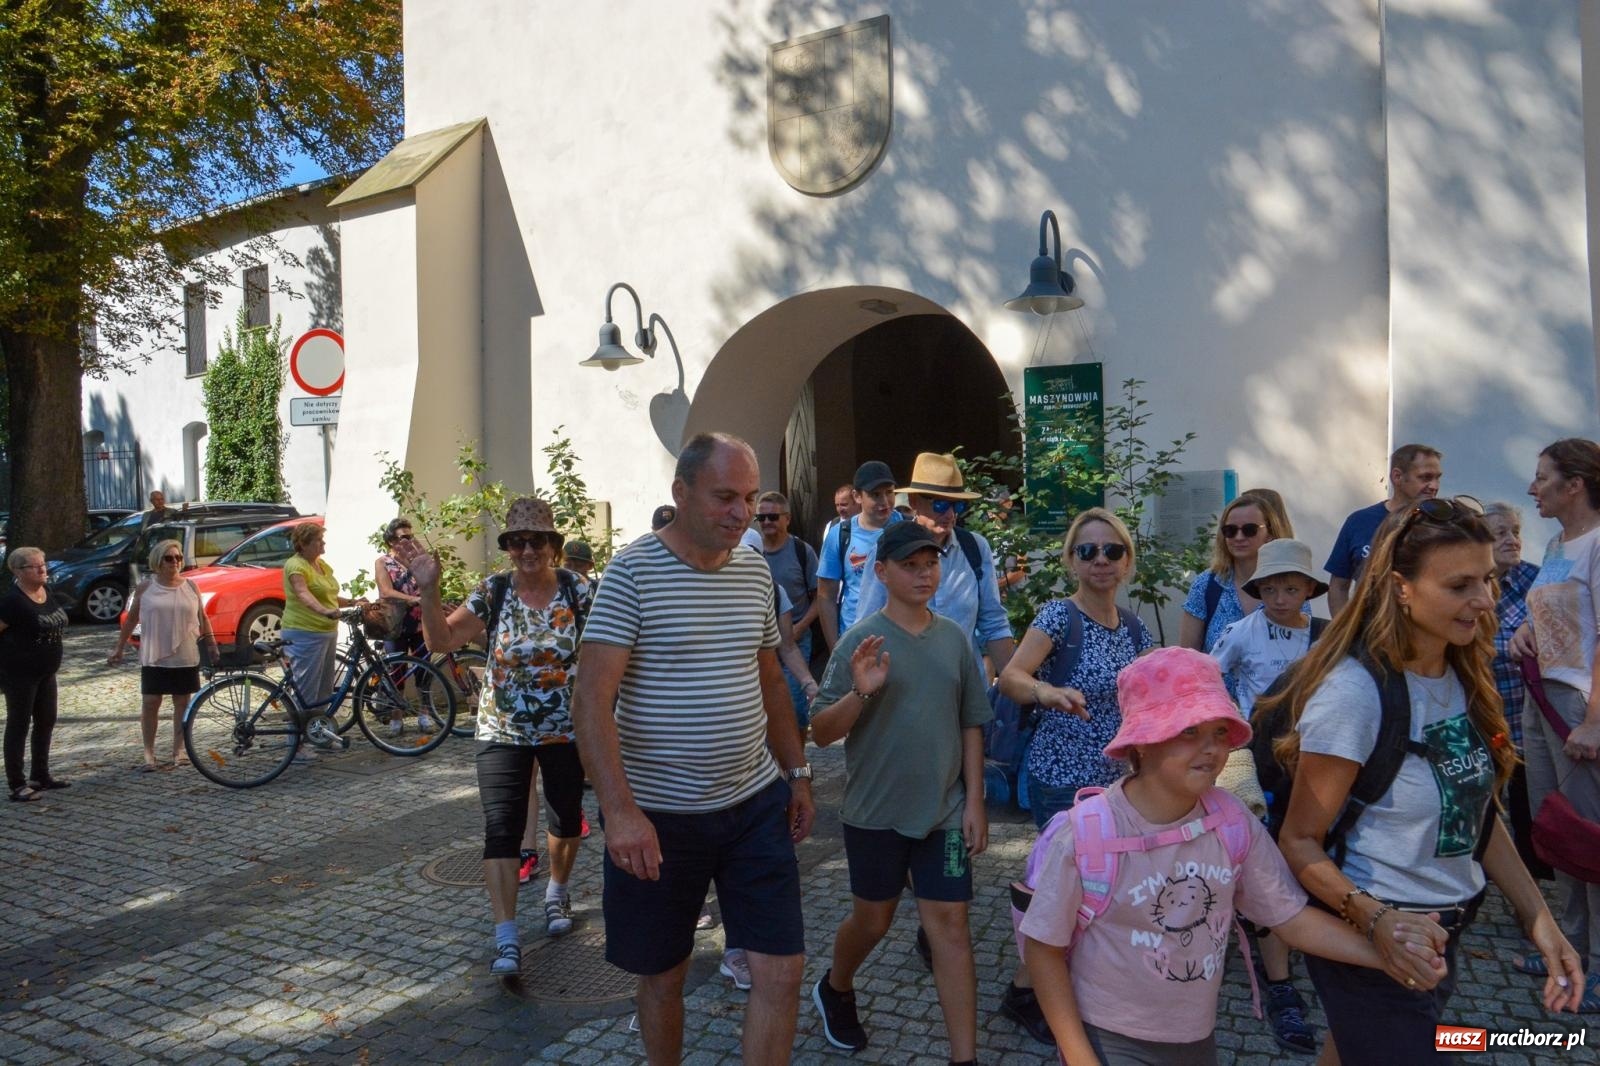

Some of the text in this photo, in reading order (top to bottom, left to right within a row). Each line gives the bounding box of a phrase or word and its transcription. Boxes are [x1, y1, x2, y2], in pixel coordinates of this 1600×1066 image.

[1029, 392, 1098, 404] MASZYNOWNIA
[1128, 871, 1168, 906] I'M
[1175, 860, 1233, 885] DOING
[1131, 929, 1163, 949] MY
